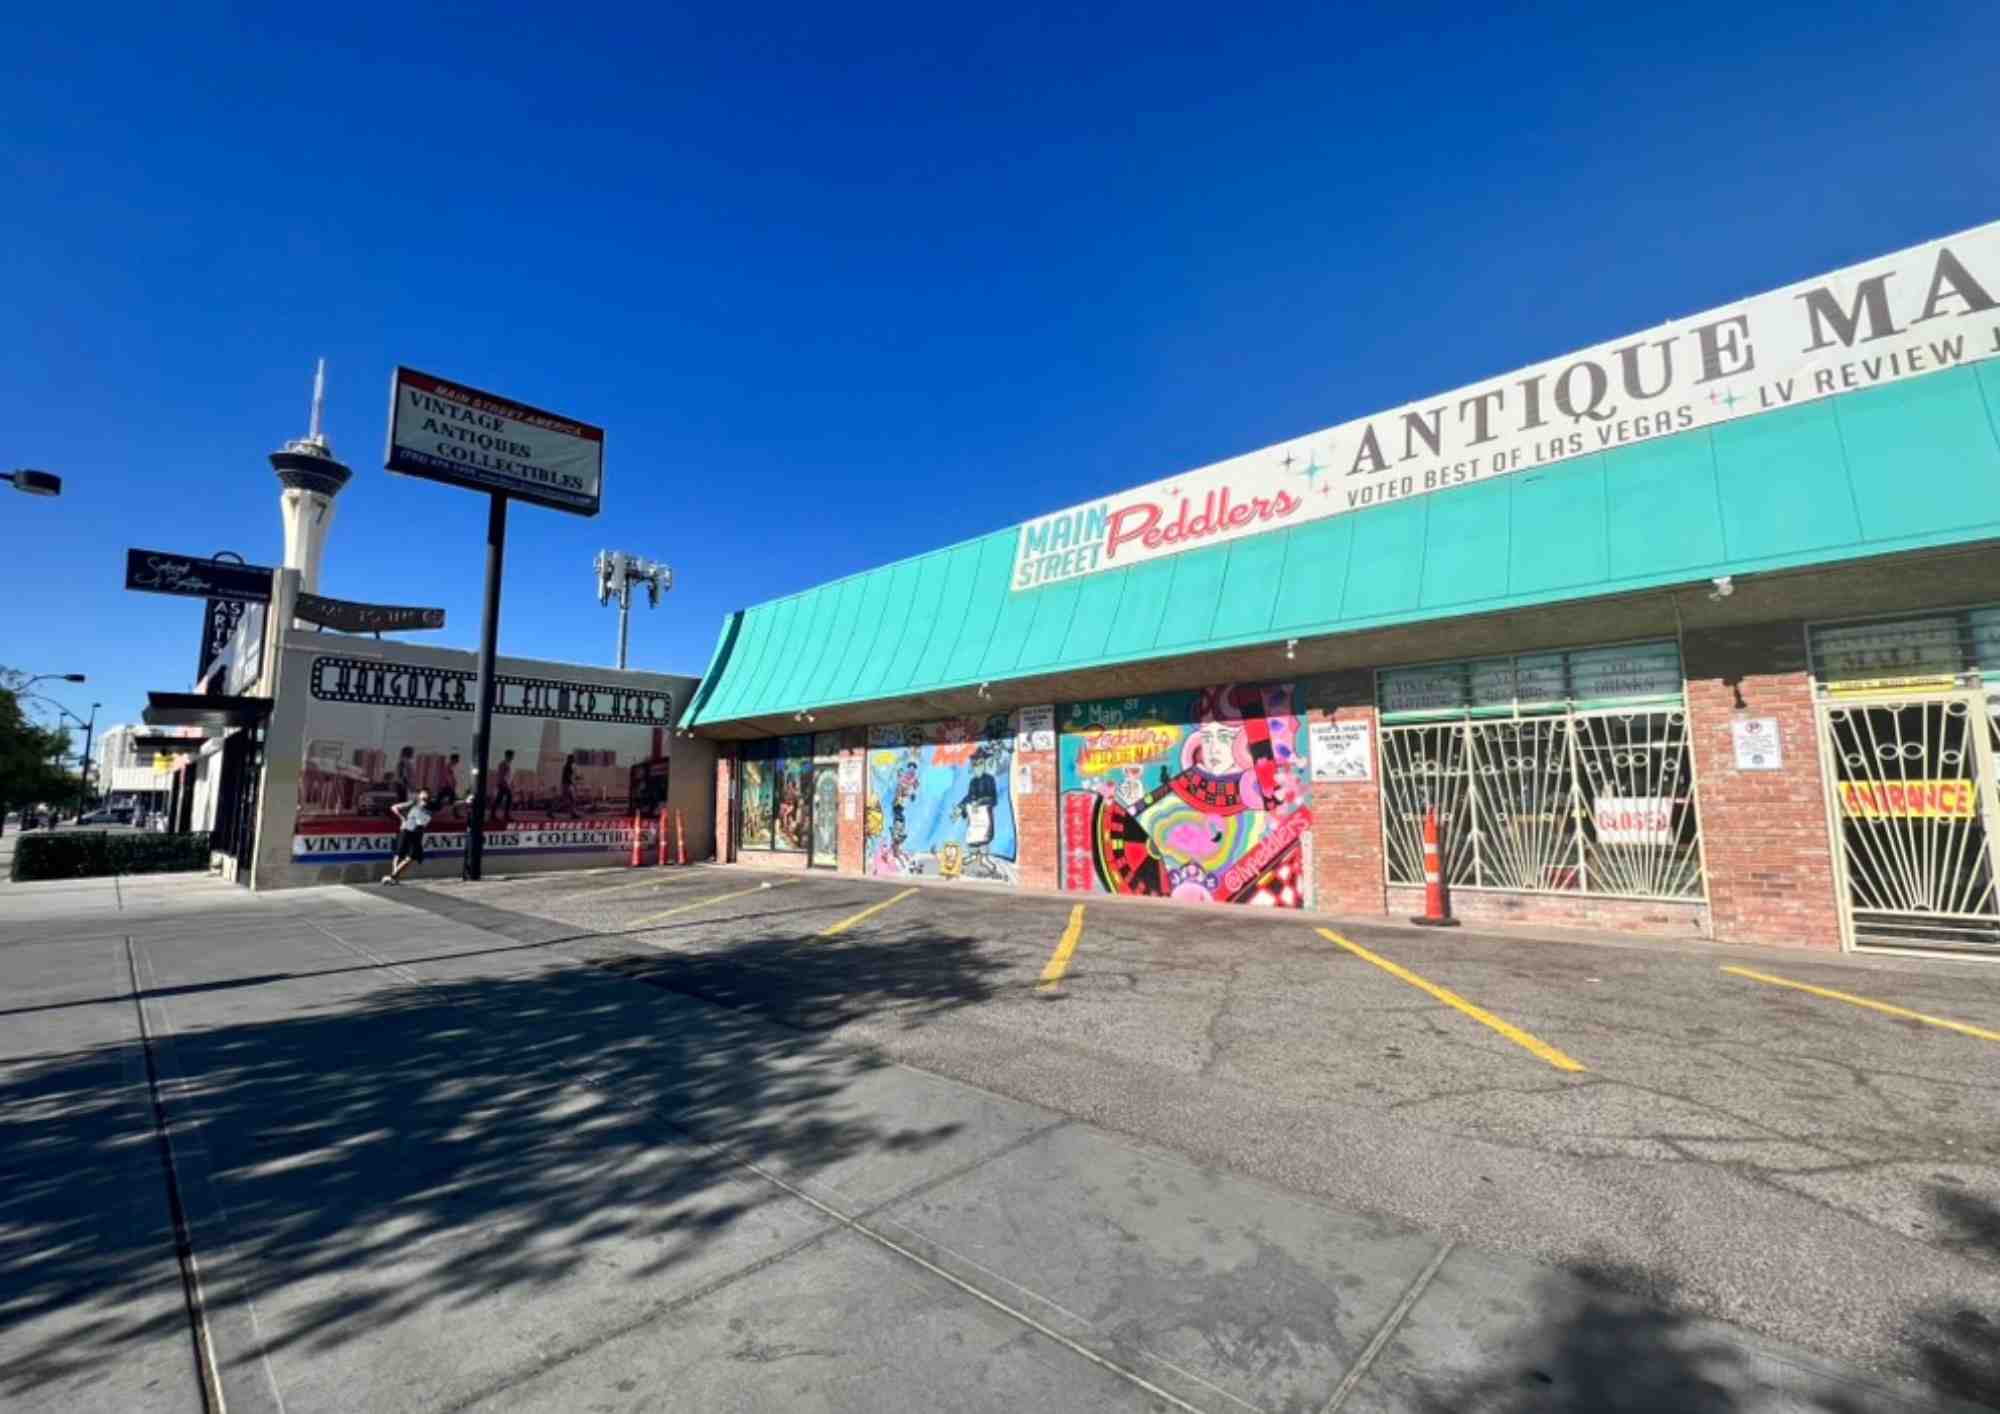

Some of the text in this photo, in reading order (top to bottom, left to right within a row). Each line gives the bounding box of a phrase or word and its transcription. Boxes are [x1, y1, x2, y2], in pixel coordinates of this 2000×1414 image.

[1345, 248, 2000, 477] ANTIQUE MA
[1758, 377, 1797, 408] LV
[1815, 334, 1965, 393] REVIEW
[410, 391, 504, 433] VINTAGE
[424, 418, 531, 459] ANTIQUES
[1346, 403, 1694, 508] VOTED BEST OF LAS VEGAS
[437, 442, 583, 490] COLLECTIBLES
[1021, 503, 1108, 560] MAIN
[1105, 486, 1303, 560] Peddlers
[1016, 542, 1103, 588] STREET
[336, 665, 466, 705] HANGOVER
[612, 694, 654, 718] HERE
[1599, 810, 1667, 832] CLOSED
[1845, 783, 1968, 817] ENTRANCE
[305, 836, 396, 851] VINTAG
[424, 833, 519, 849] ANTUES
